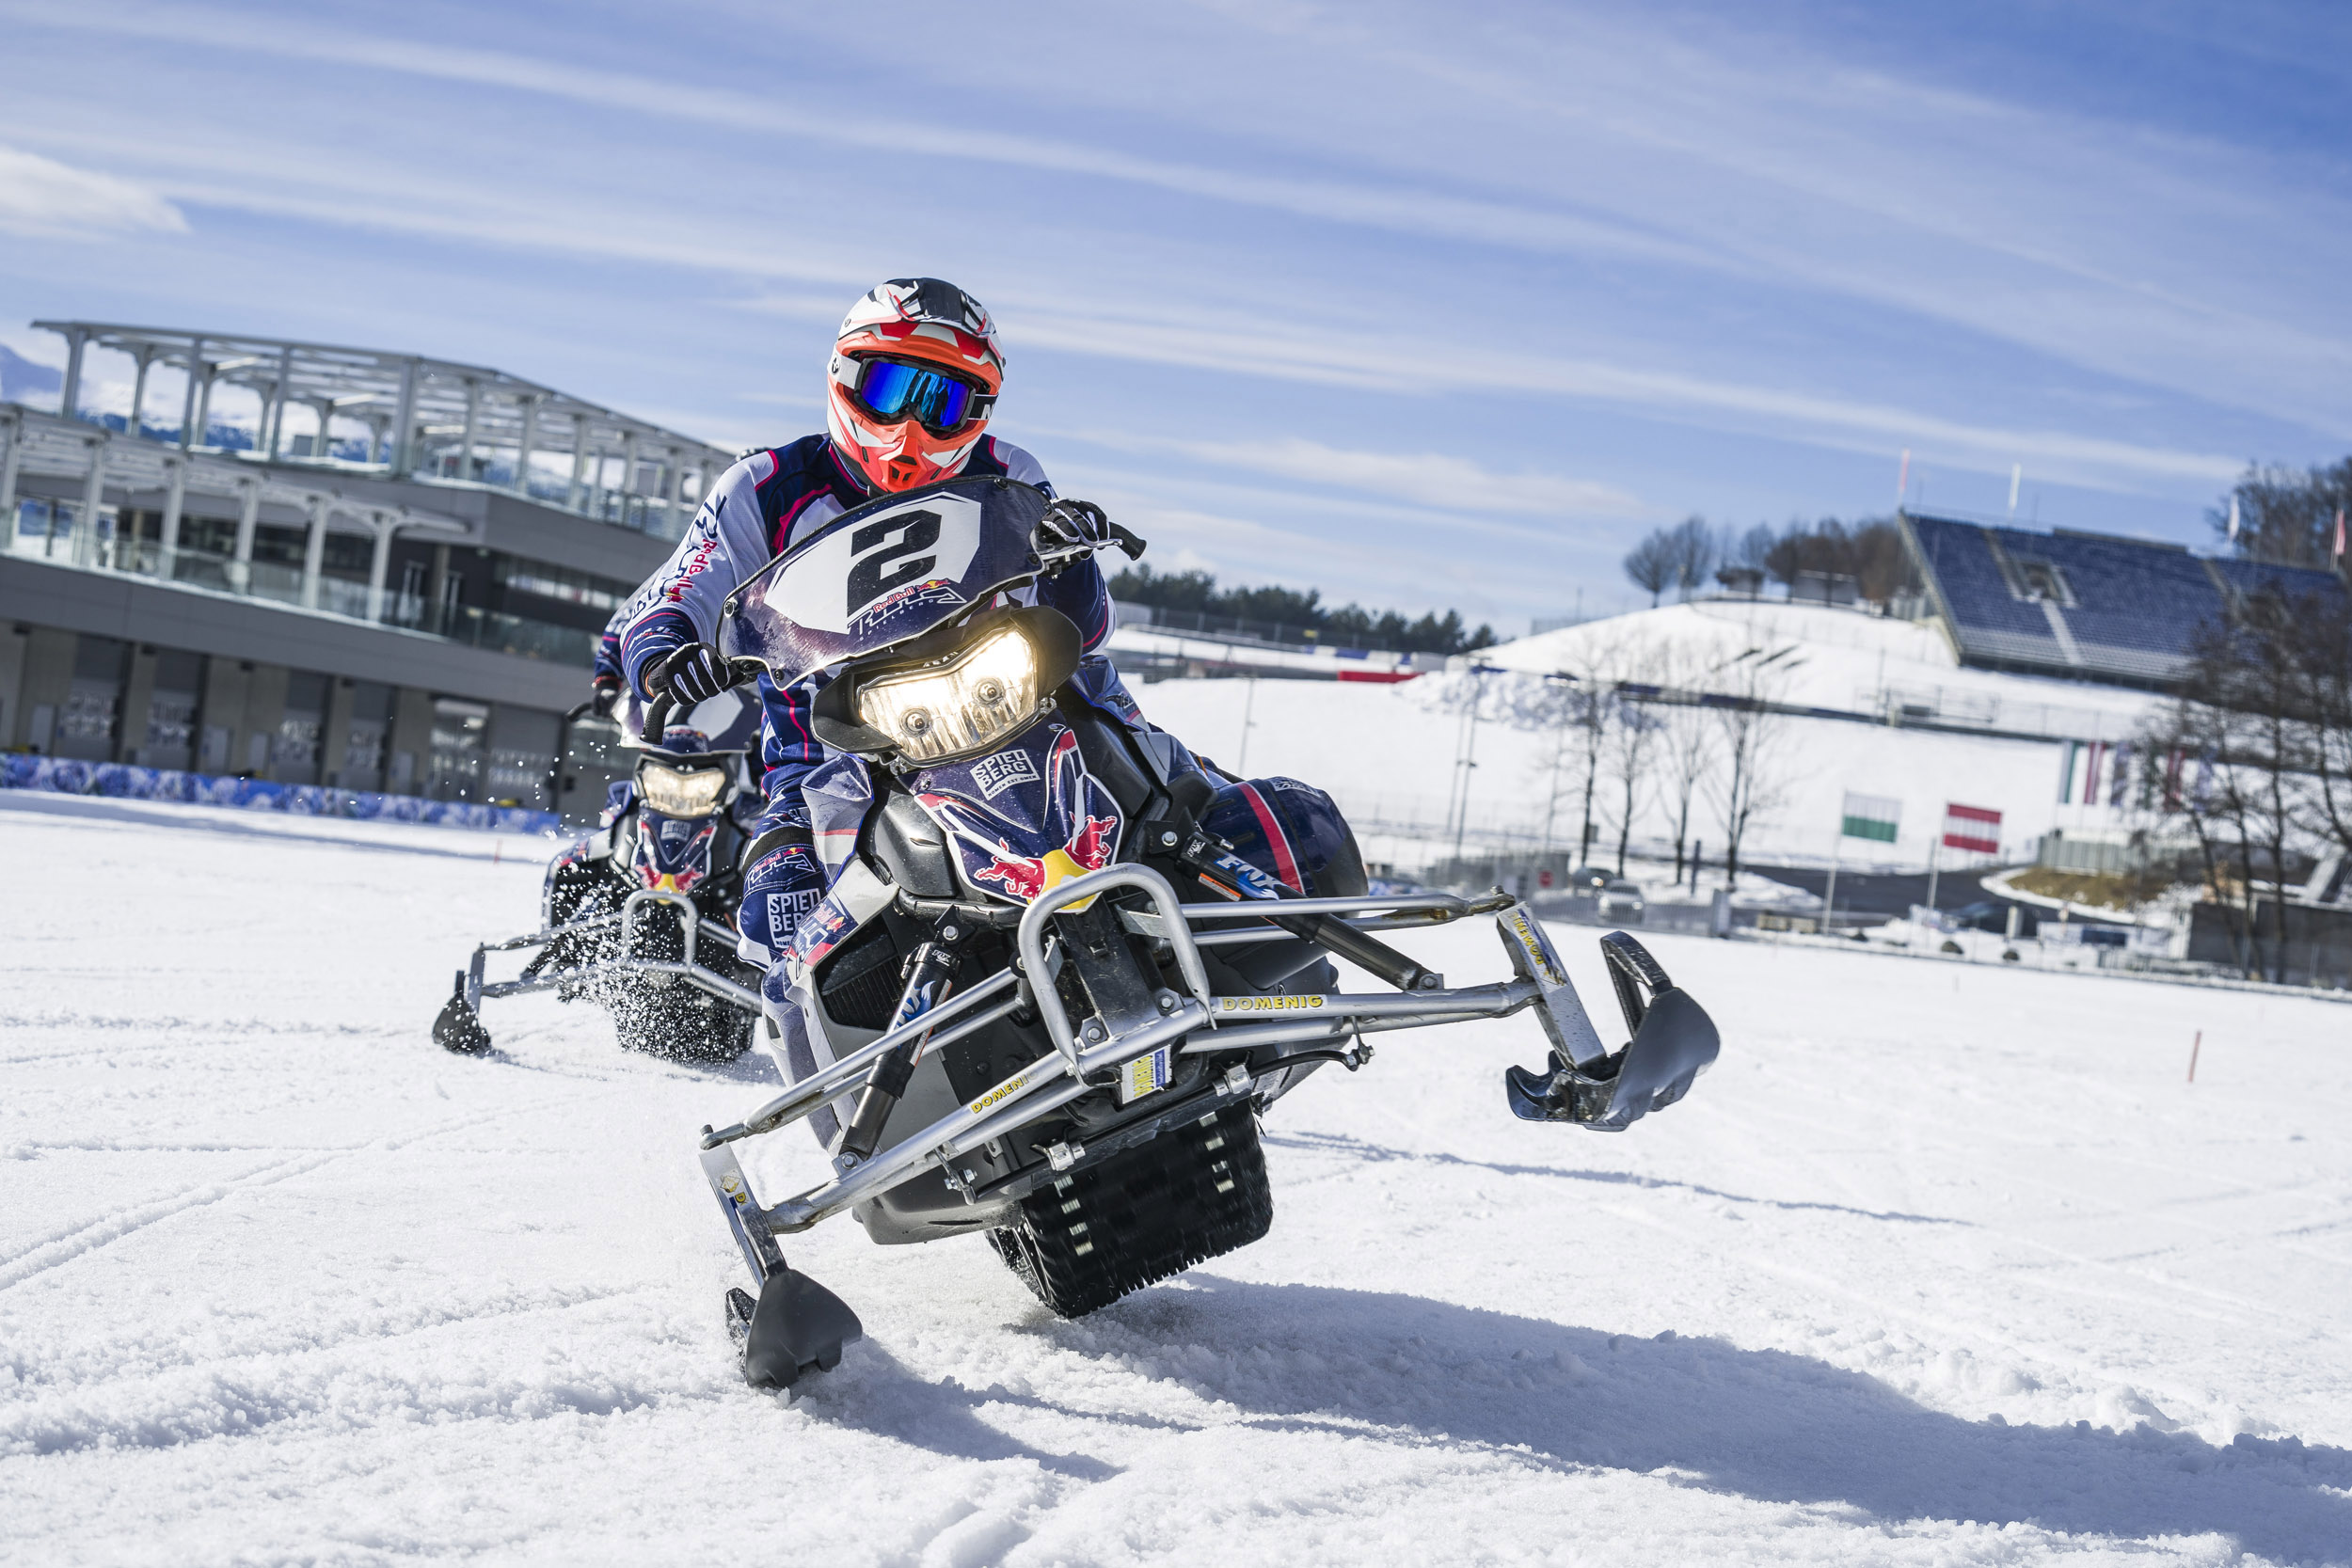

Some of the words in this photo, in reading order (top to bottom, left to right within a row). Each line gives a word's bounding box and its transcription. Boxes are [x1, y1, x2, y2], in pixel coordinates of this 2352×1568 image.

[847, 509, 943, 618] 2
[873, 596, 895, 614] Red
[893, 587, 916, 602] Bull
[975, 751, 1027, 780] SPIEL
[979, 761, 1028, 790] BERG
[1214, 853, 1287, 889] FOX
[771, 912, 805, 932] BER
[1223, 995, 1324, 1011] DOMENIG
